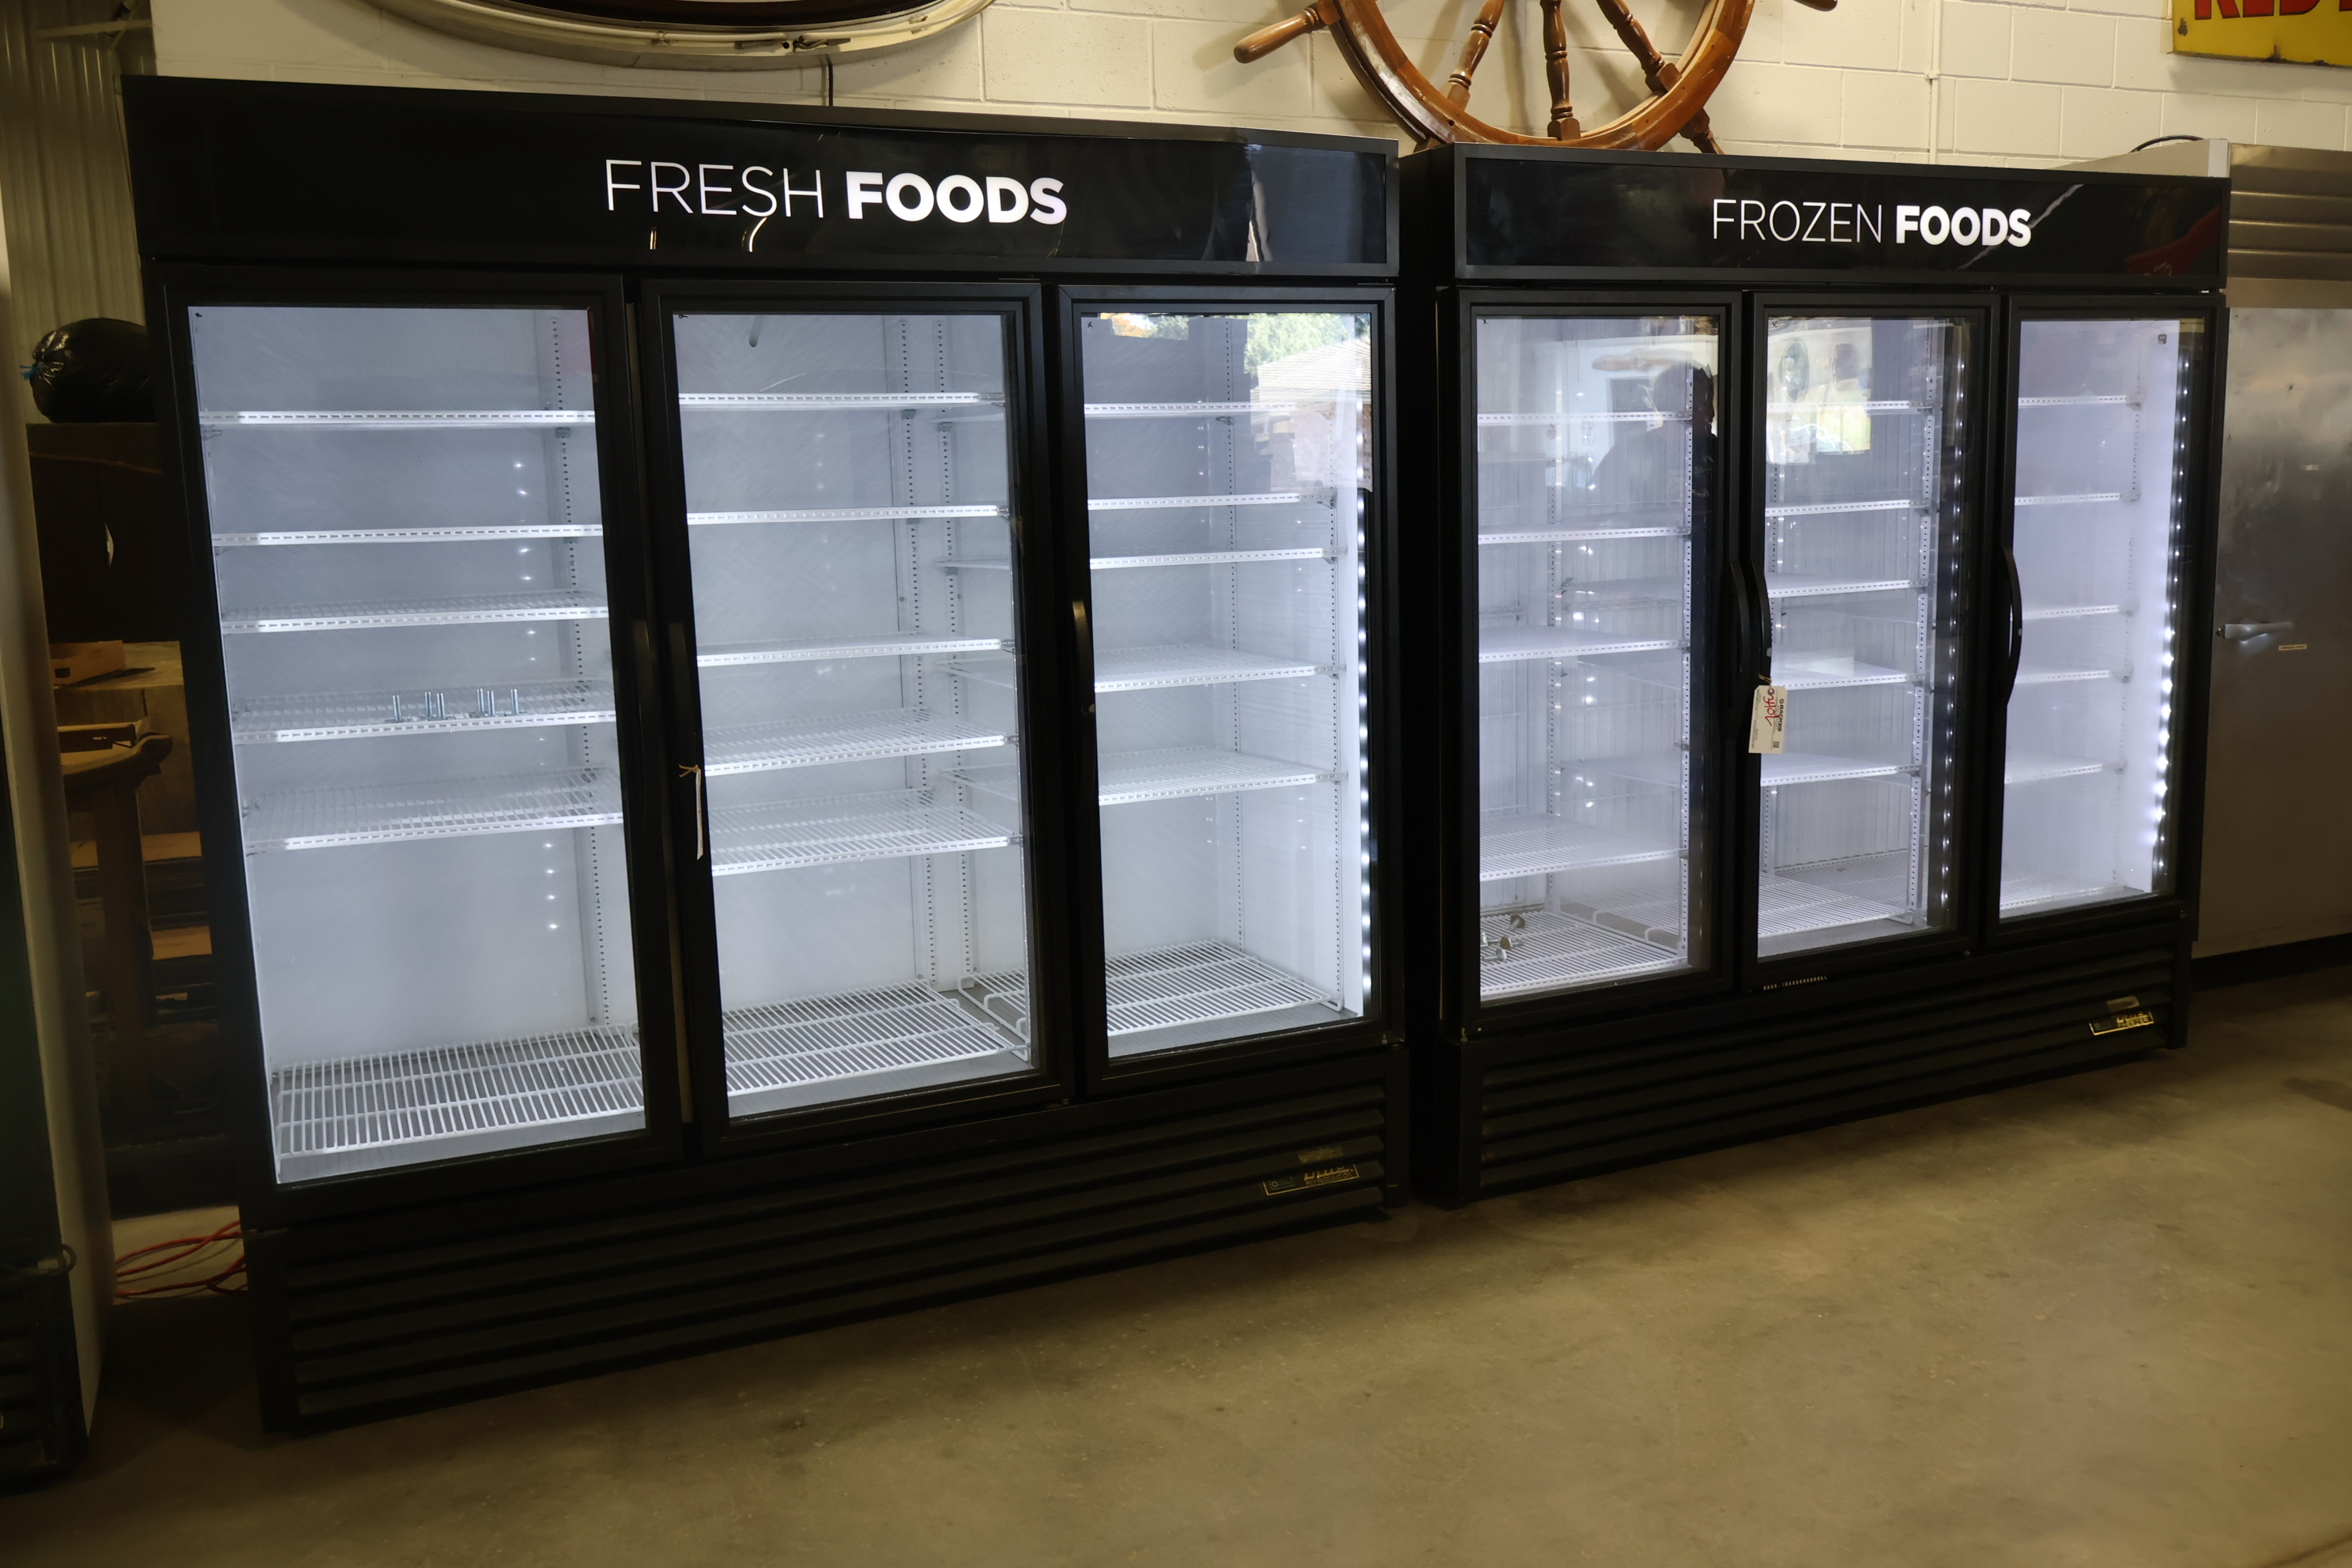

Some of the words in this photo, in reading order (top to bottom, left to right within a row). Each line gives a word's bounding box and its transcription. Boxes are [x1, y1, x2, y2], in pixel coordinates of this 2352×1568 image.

[606, 160, 823, 217] FRESH
[846, 172, 1066, 224] FOODS
[1714, 199, 1881, 243] FROZEN
[1897, 205, 2030, 247] FOODS
[1305, 1171, 1352, 1186] REFRIGERATOR
